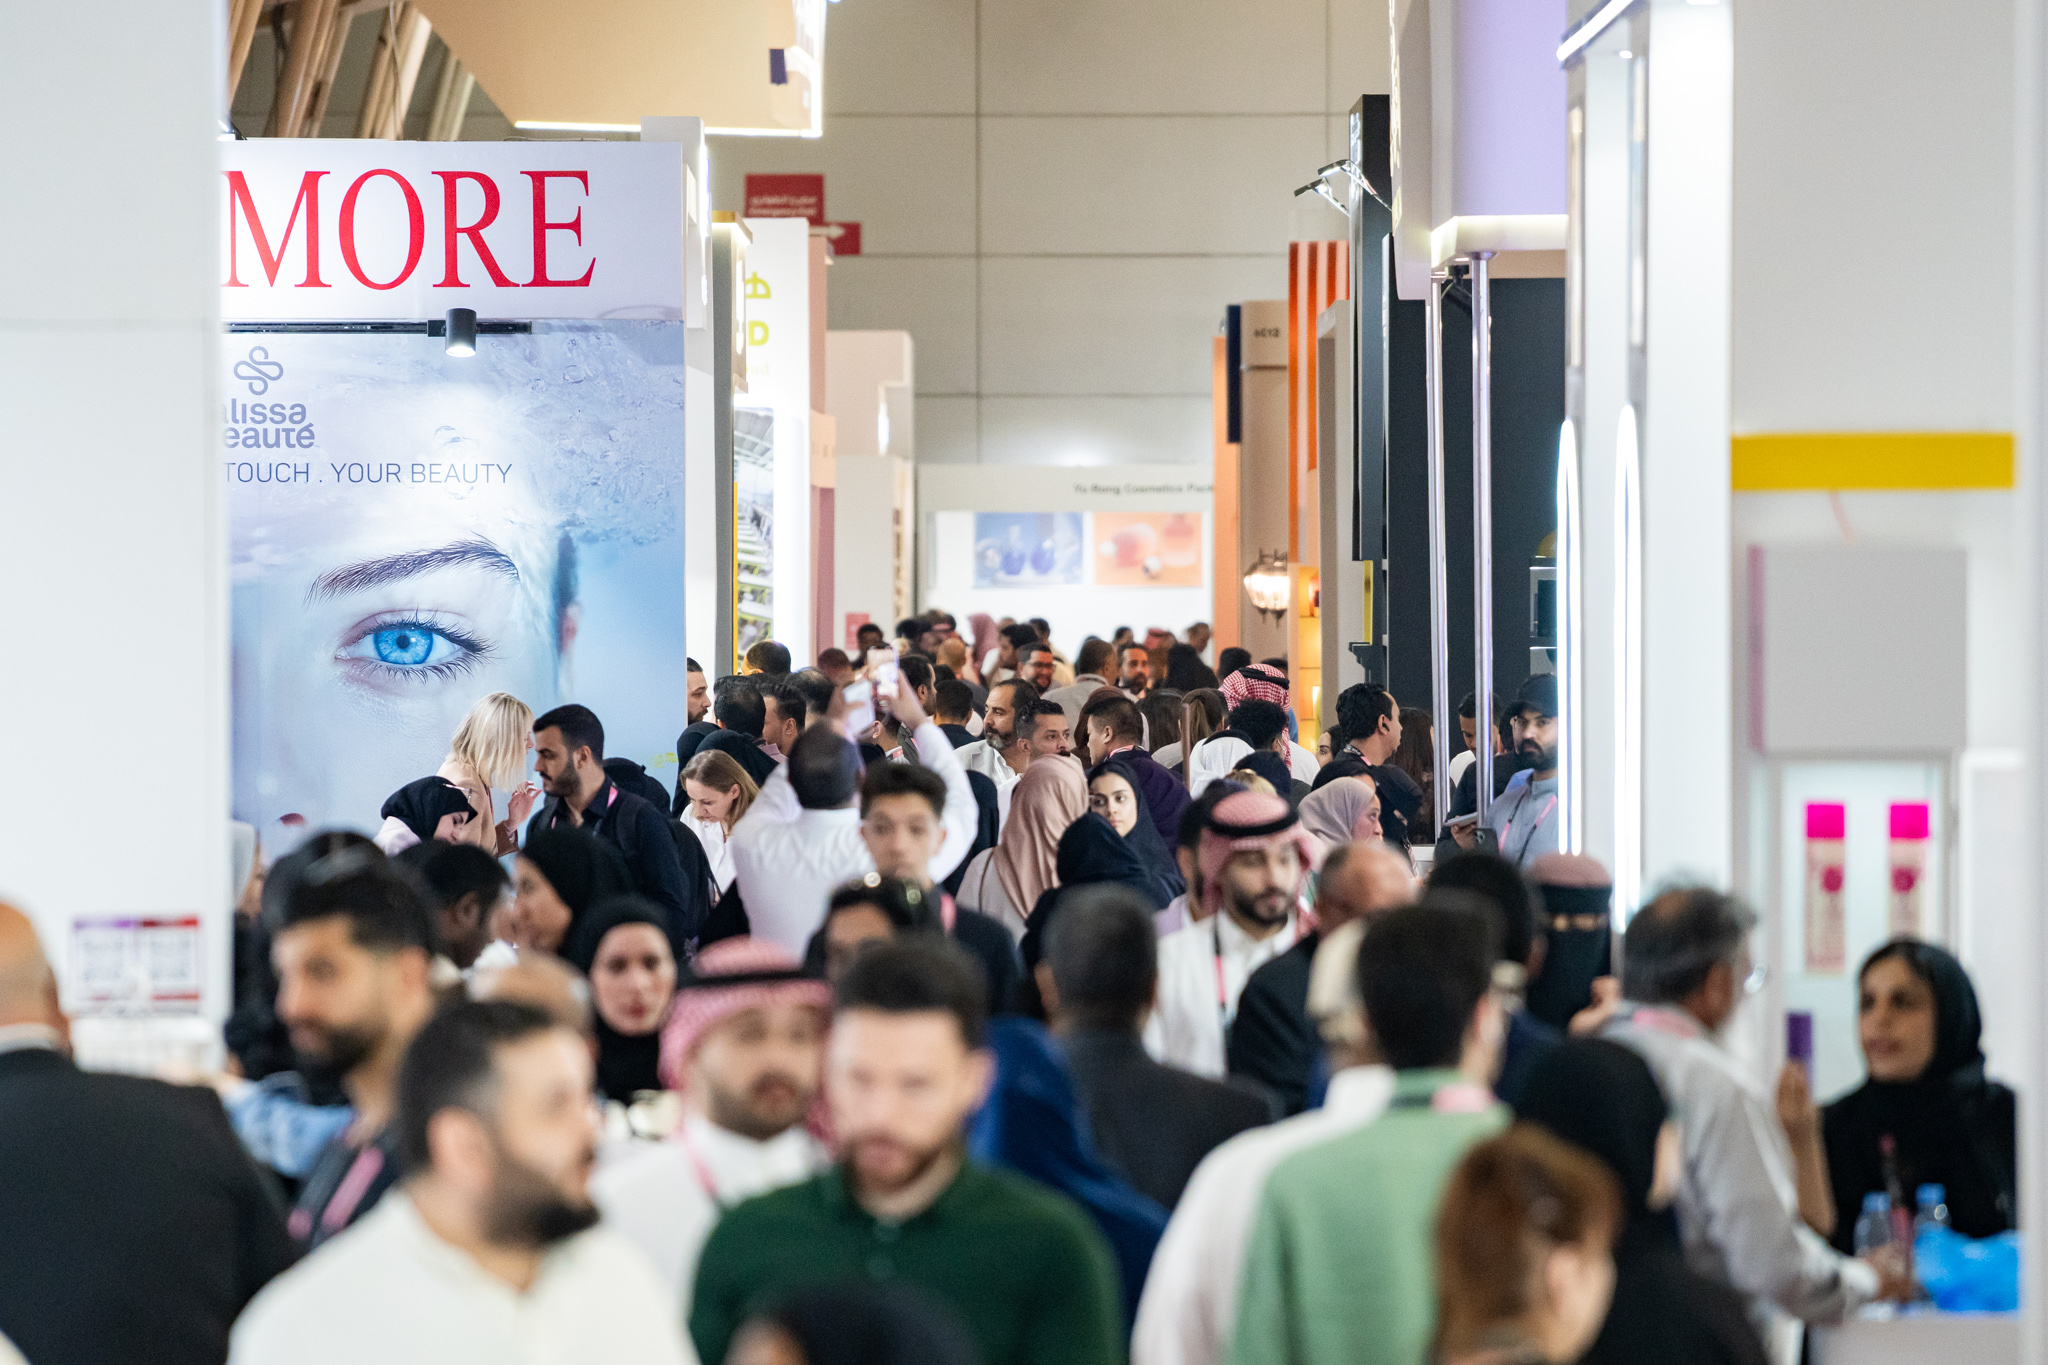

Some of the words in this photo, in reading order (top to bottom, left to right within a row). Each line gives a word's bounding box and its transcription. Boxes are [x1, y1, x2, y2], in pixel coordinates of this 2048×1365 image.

[220, 168, 596, 290] MORE
[222, 462, 309, 483] TOUCH
[330, 462, 401, 483] YOUR
[411, 463, 513, 483] BEAUTY
